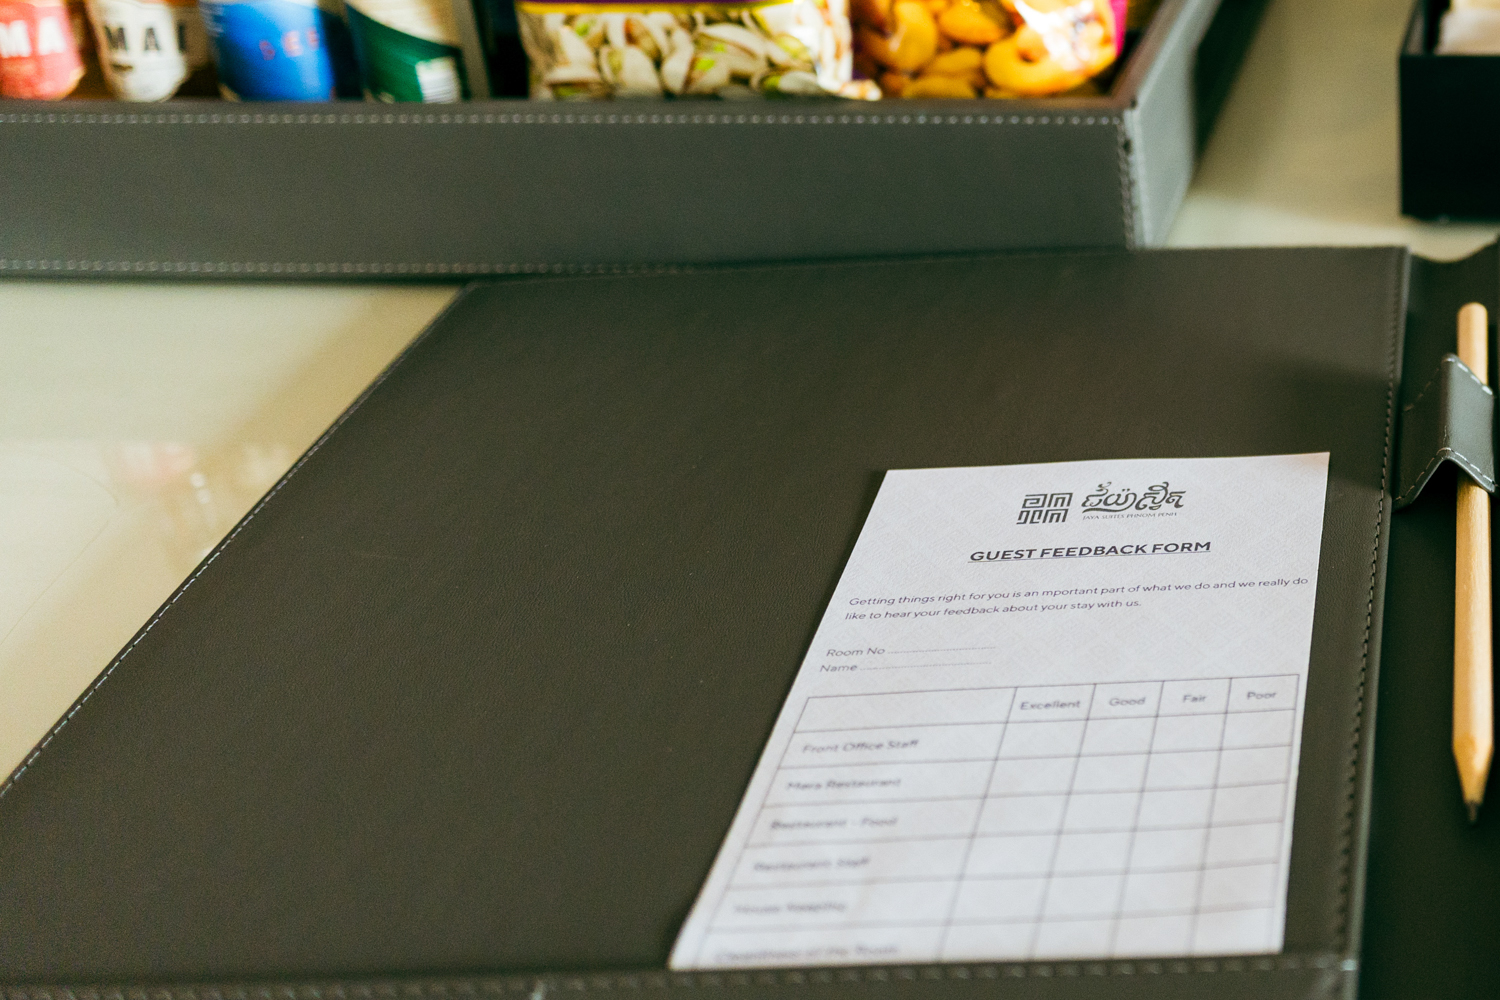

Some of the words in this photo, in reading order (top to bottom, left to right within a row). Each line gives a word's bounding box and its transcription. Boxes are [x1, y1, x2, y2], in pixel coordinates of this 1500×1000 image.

[969, 549, 1038, 562] GUEST
[1039, 544, 1148, 558] FEEDBACK
[1151, 541, 1212, 553] FORM
[849, 597, 895, 606] Getting
[898, 595, 935, 604] things
[938, 593, 966, 603] right
[969, 592, 985, 600] for
[987, 592, 1010, 600] you
[1100, 585, 1125, 595] part
[1127, 584, 1141, 593] of
[1142, 583, 1172, 592] what
[1194, 582, 1210, 590] do
[1212, 581, 1236, 589] and
[1258, 578, 1290, 587] really
[1292, 577, 1308, 585] do
[845, 612, 867, 620] like
[869, 611, 882, 620] to
[884, 610, 911, 619] hear
[913, 609, 940, 619] your
[943, 606, 1000, 616] feedback
[1002, 604, 1038, 613] about
[1040, 603, 1068, 613] your
[1070, 602, 1095, 611] stay
[1096, 600, 1122, 609] with
[826, 649, 864, 658] Room
[866, 647, 886, 656] No
[819, 664, 858, 673] Name
[1020, 699, 1081, 711] Excellent
[1108, 696, 1146, 707] Good
[1182, 694, 1207, 704] Fair
[1246, 690, 1277, 700] Poor
